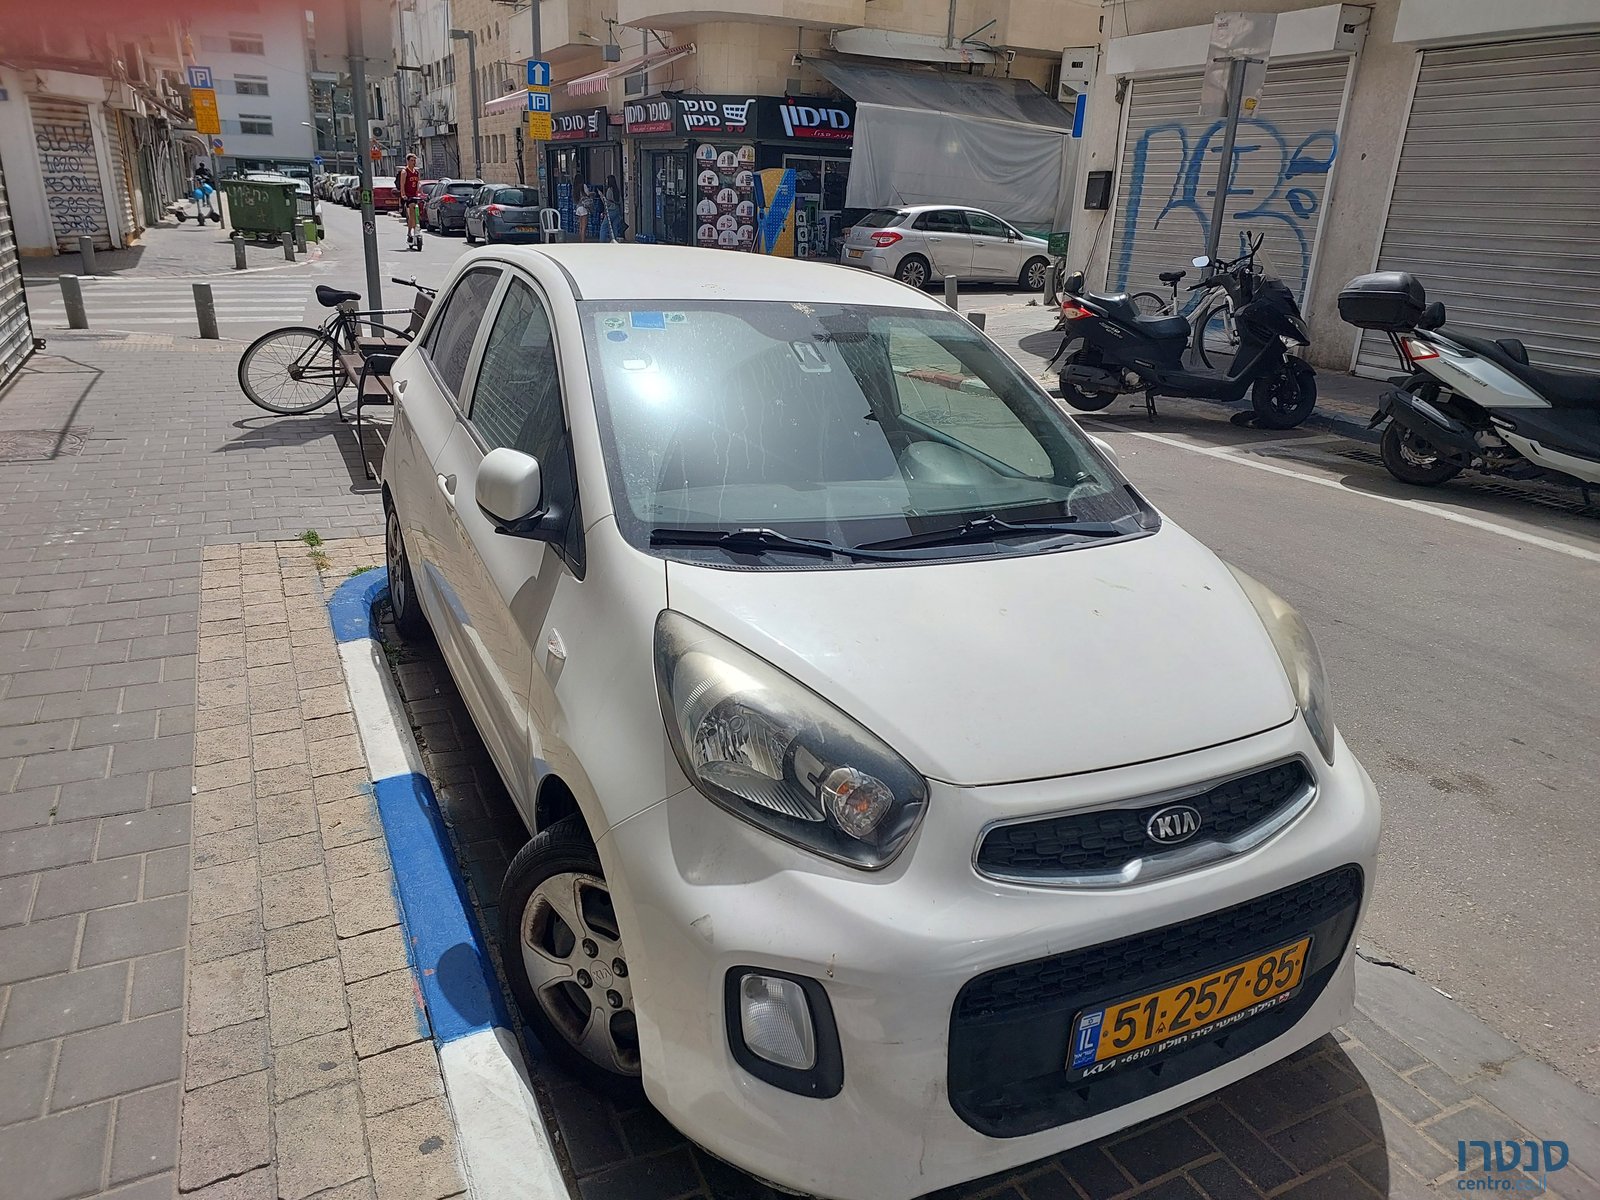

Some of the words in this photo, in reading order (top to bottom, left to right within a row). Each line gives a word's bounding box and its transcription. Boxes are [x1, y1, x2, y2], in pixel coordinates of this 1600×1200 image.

[647, 101, 671, 122] סופר
[678, 99, 717, 113] סופר
[559, 114, 585, 132] סופר
[682, 113, 721, 131] מימון
[779, 104, 850, 137] מימון
[1157, 811, 1196, 839] KIA
[591, 966, 613, 981] KIA
[1246, 999, 1277, 1018] הילוך
[1215, 1013, 1246, 1029] שישי
[1079, 1028, 1094, 1051] IL
[1190, 1025, 1214, 1040] קיה
[1158, 1036, 1189, 1053] חולון
[1082, 1059, 1117, 1078] KIA
